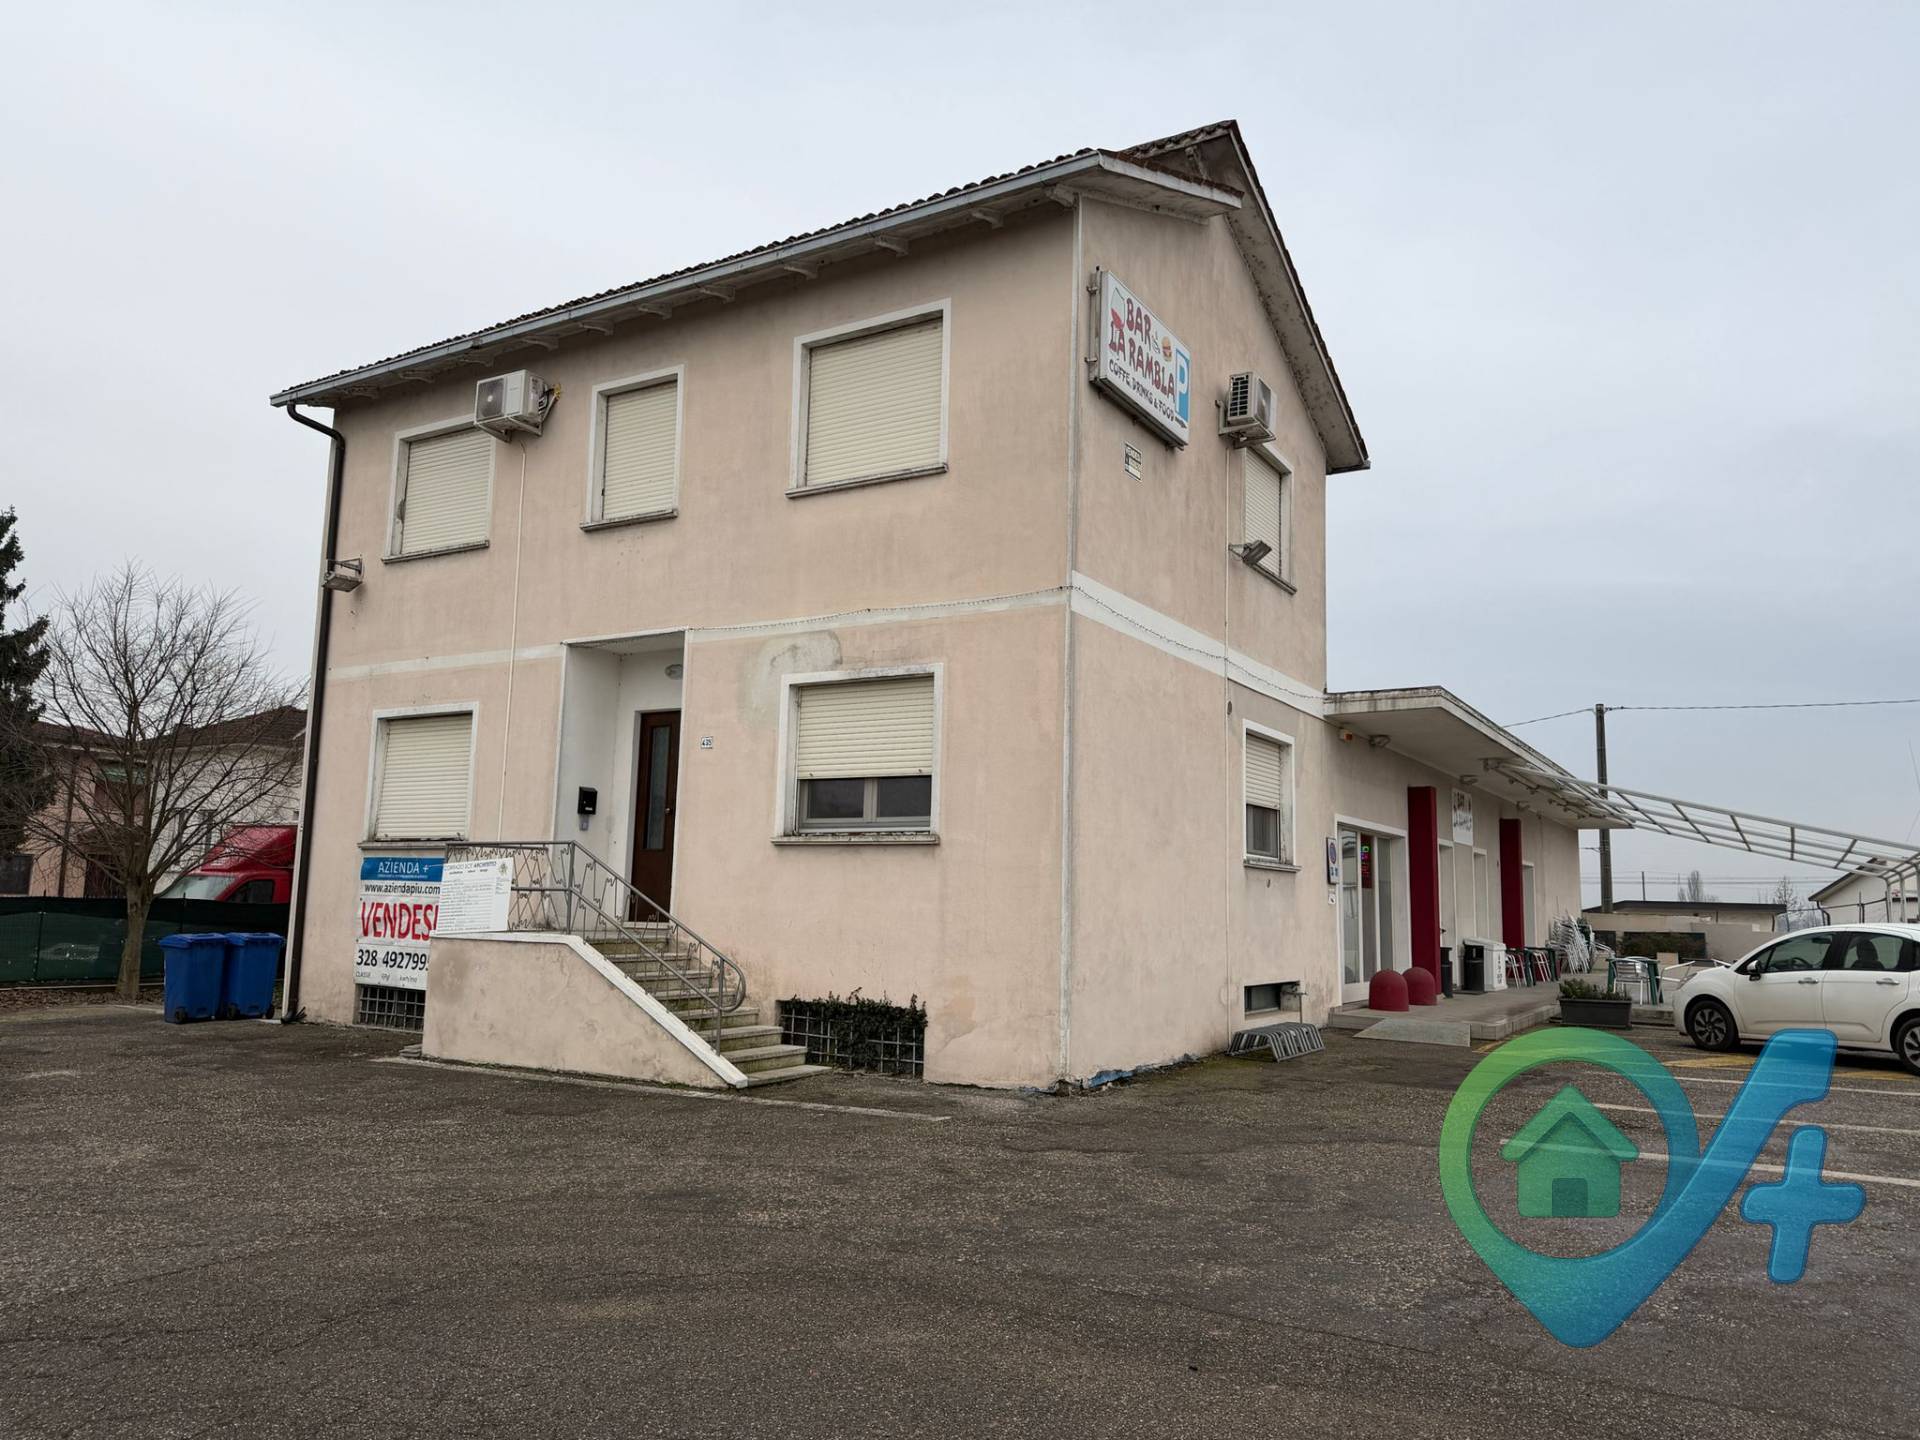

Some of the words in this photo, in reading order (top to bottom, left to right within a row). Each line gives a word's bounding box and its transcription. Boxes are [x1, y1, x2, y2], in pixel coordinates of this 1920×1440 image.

[1126, 298, 1151, 350] BAR
[1109, 321, 1126, 362] LA
[1129, 337, 1175, 404] RAMBLA
[1176, 351, 1188, 413] P
[1158, 399, 1175, 422] FOOD
[378, 861, 420, 874] AZIENDA
[364, 882, 441, 896] www.aziendapiu.com
[361, 902, 439, 941] VENDESI
[356, 949, 378, 967] 328
[382, 951, 429, 971] 492799
